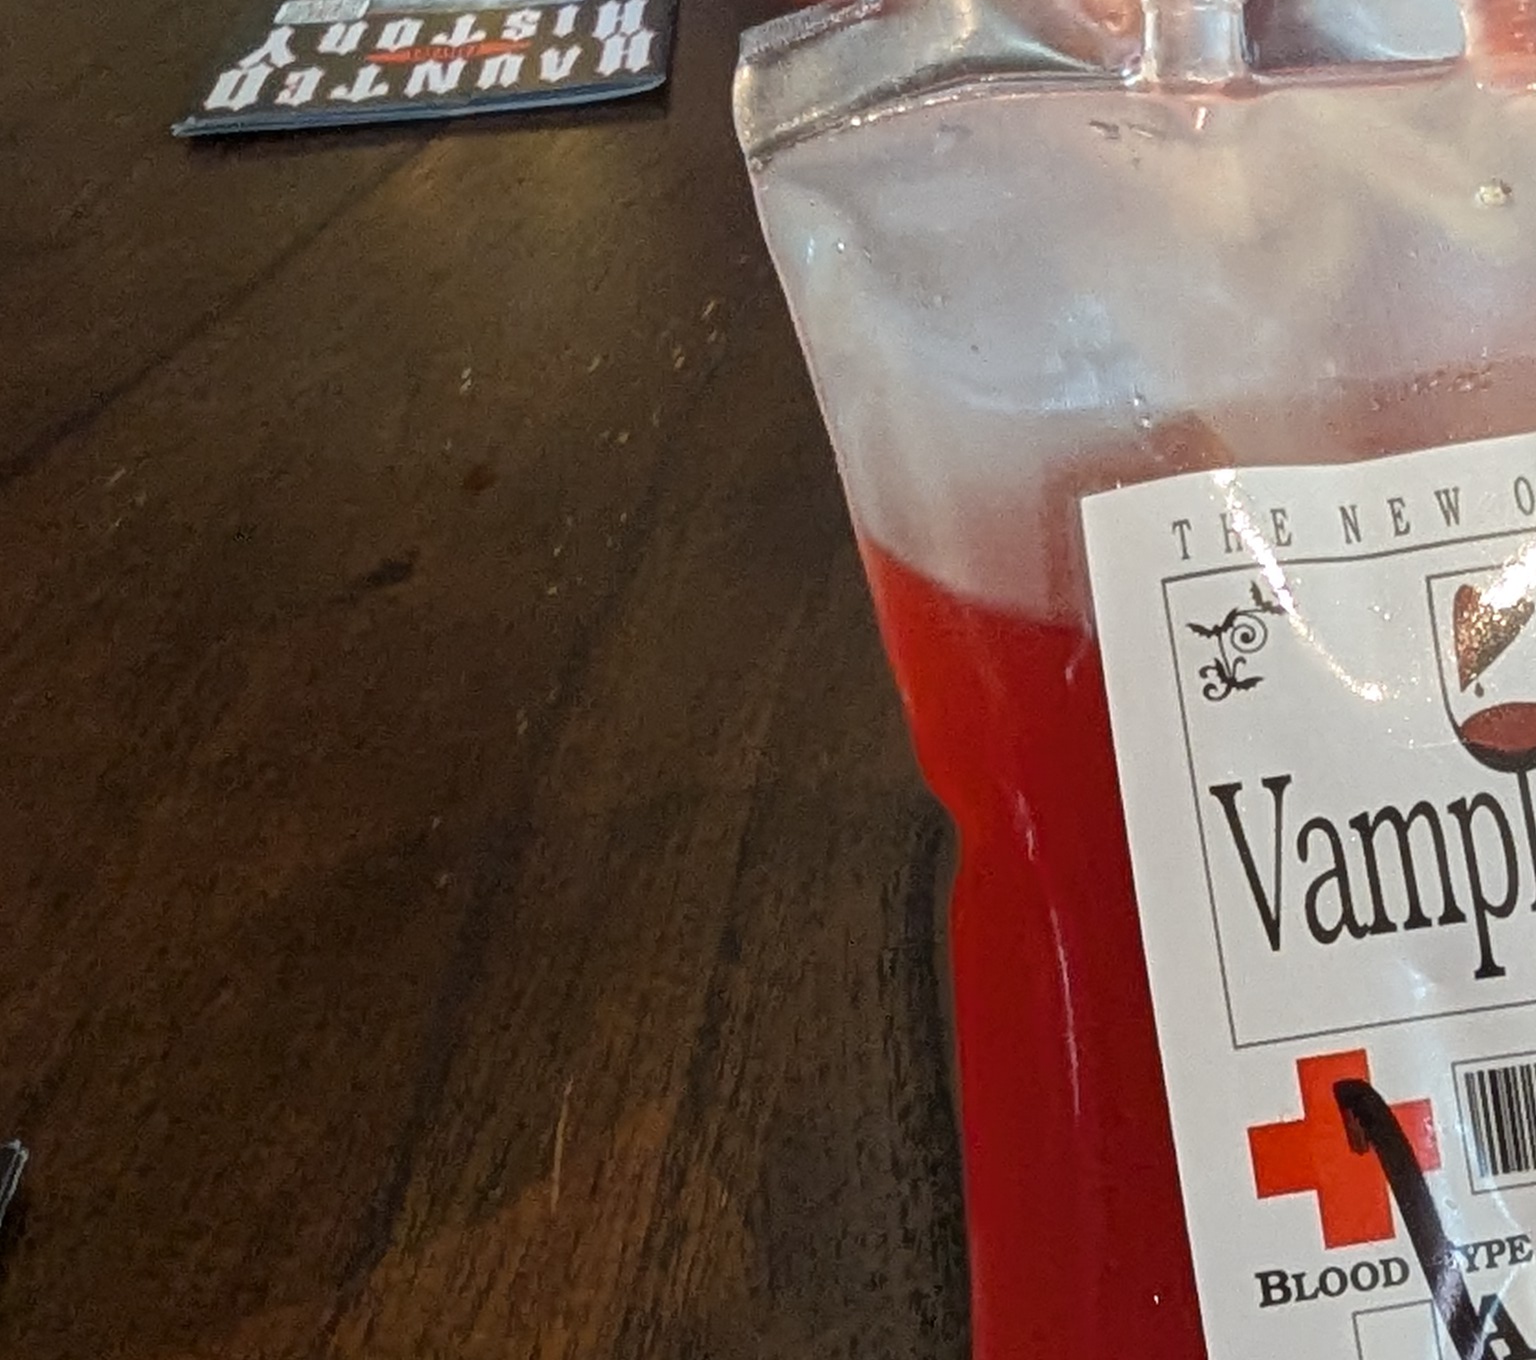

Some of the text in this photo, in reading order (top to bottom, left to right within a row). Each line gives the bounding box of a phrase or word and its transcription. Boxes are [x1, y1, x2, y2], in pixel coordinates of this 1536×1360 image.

[202, 28, 657, 113] HAUNTED
[1171, 507, 1292, 561] THE
[1338, 486, 1461, 545] NEW
[1255, 1255, 1410, 1308] BLOOD
[1449, 1232, 1535, 1274] YPE
